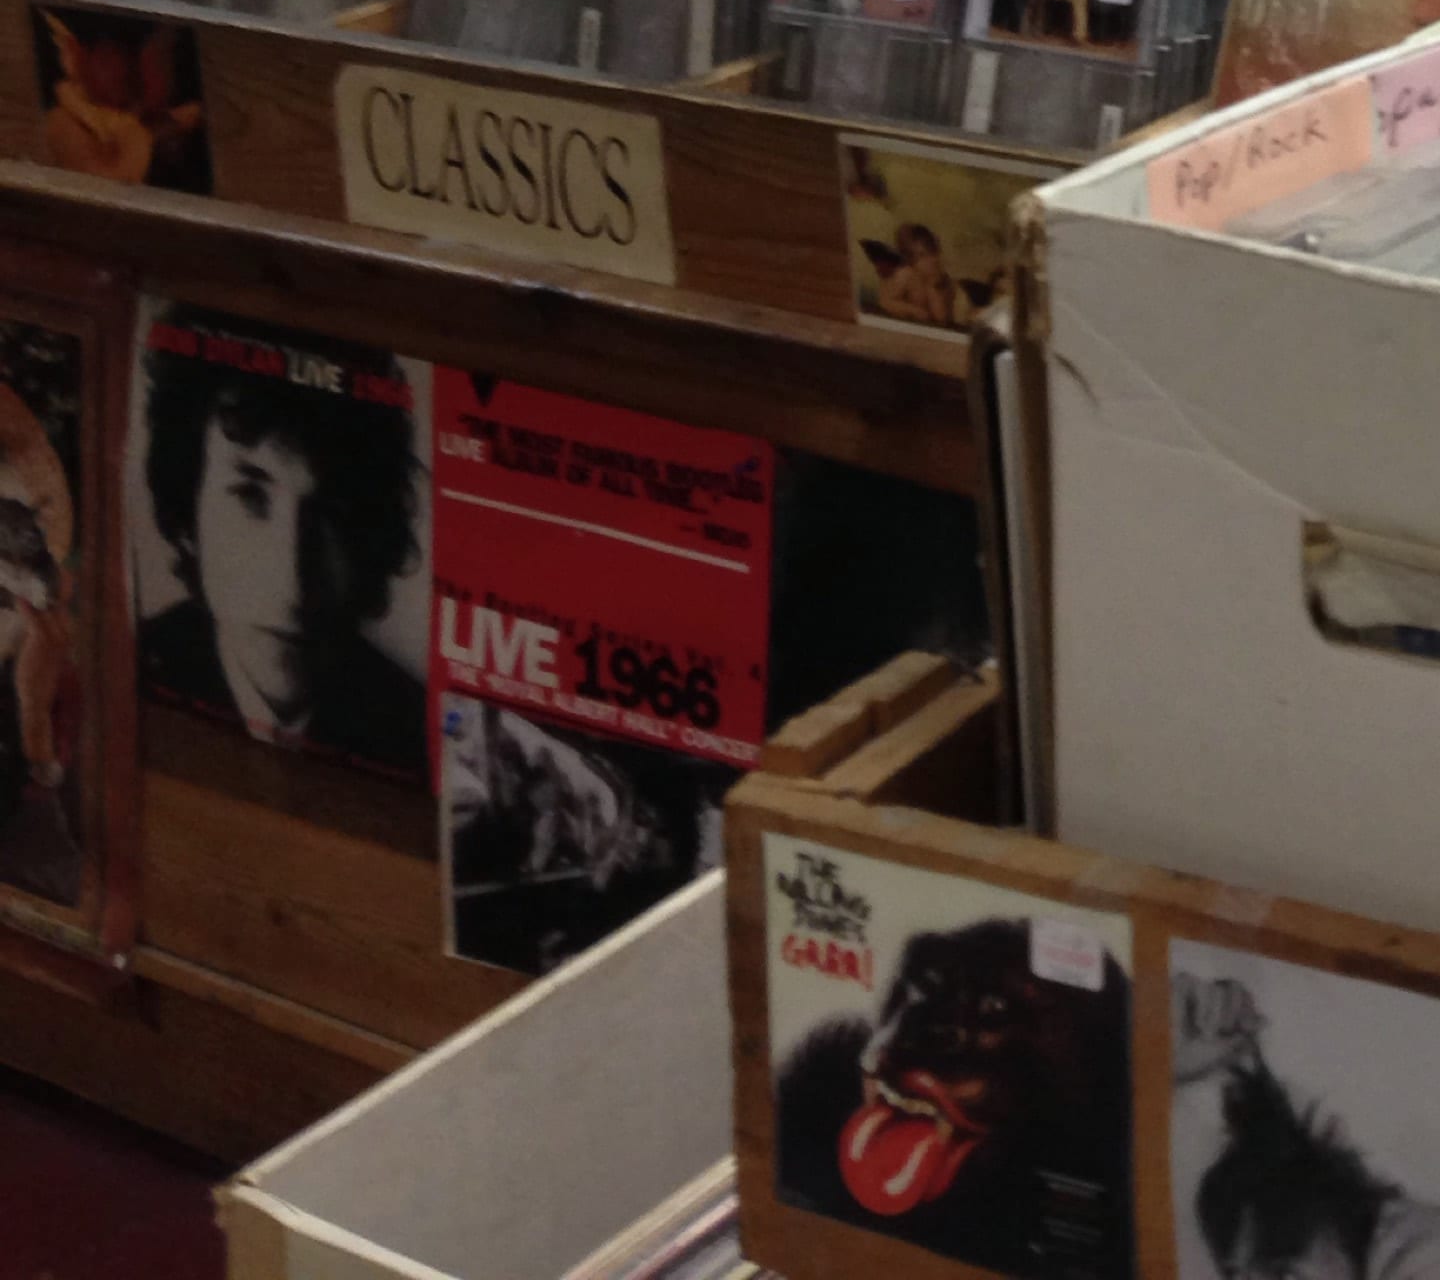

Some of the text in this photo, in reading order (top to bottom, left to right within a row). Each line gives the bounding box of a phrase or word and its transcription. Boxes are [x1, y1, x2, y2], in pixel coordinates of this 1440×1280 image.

[362, 85, 638, 246] CLASSICS
[439, 595, 722, 730] LIVE 1966
